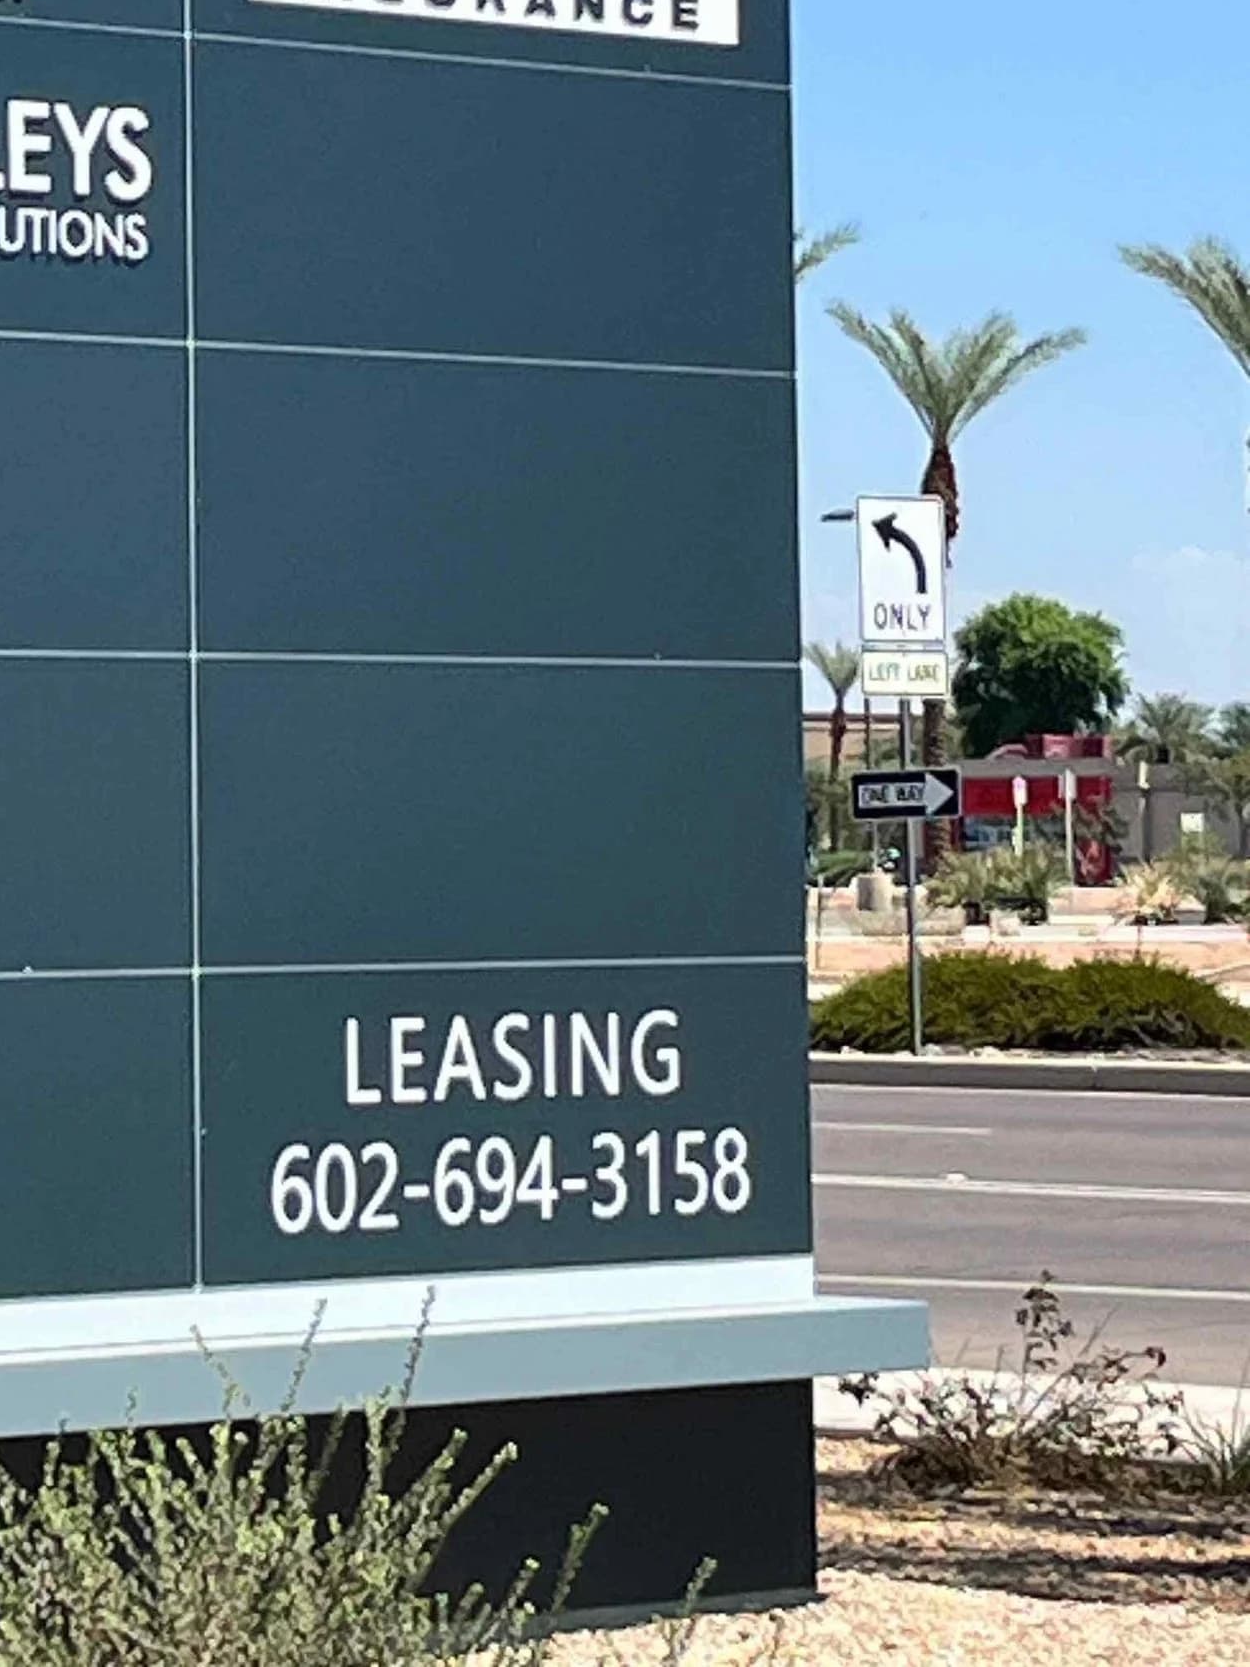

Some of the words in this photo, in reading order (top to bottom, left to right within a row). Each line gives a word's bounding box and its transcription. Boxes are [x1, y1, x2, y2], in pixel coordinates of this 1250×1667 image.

[873, 602, 932, 632] ONLY
[861, 784, 891, 805] ONE
[896, 784, 925, 804] WAY
[345, 1009, 682, 1105] LEASING
[270, 1126, 751, 1234] 602-694-3158
